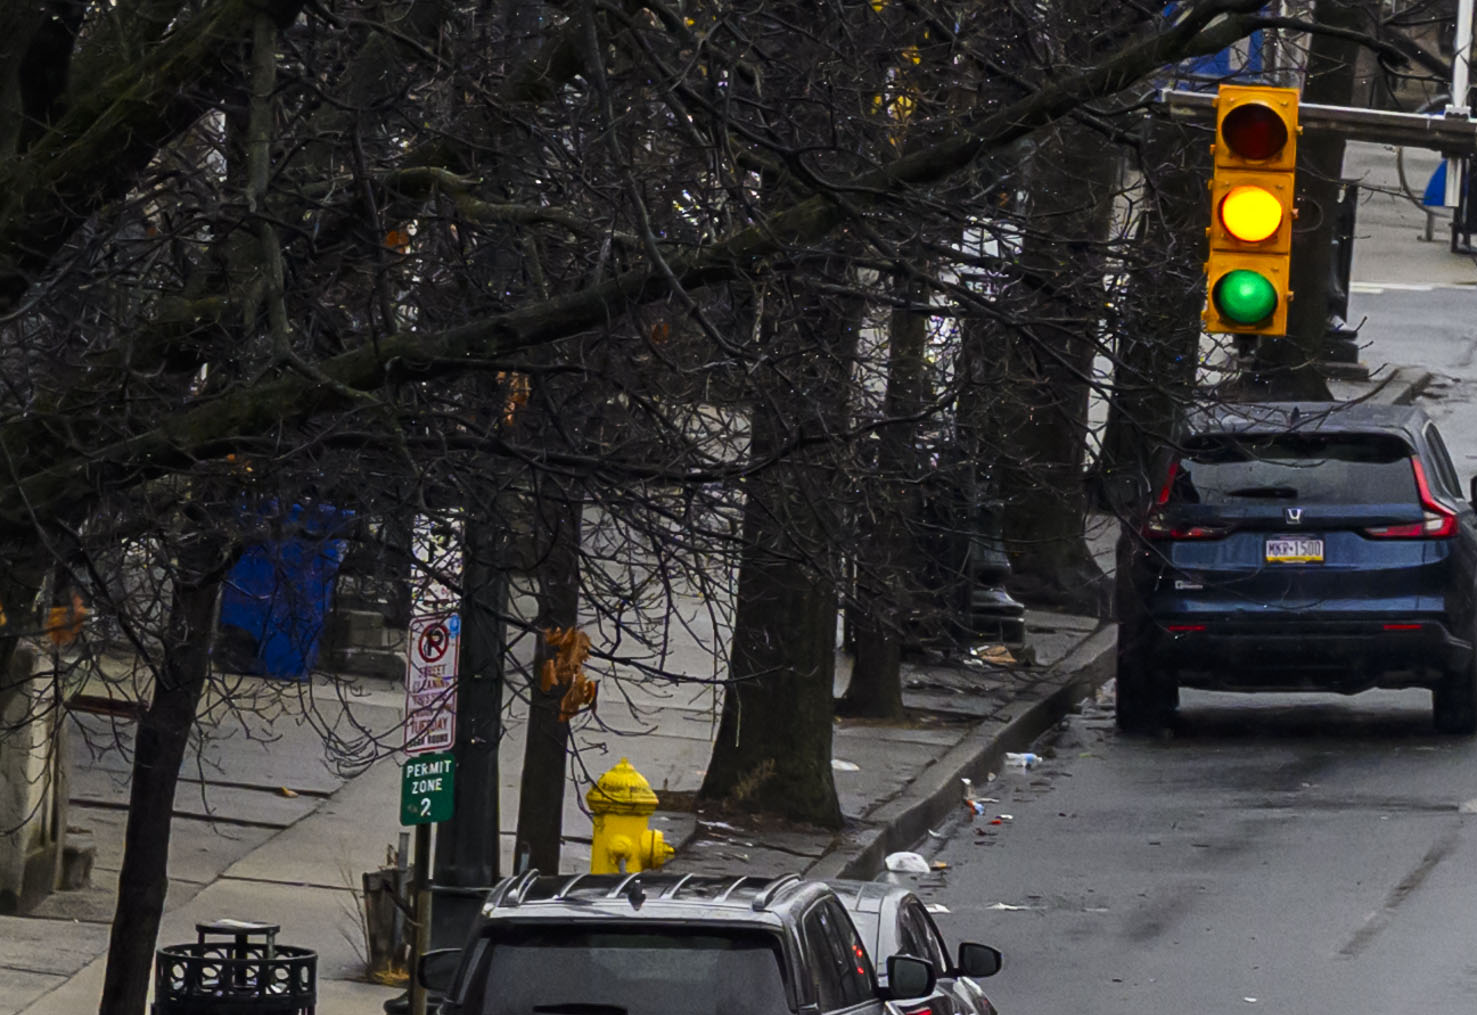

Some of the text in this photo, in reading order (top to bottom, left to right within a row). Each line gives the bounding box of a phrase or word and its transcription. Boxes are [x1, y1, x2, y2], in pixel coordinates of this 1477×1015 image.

[406, 760, 452, 778] PERMIT
[412, 778, 443, 794] ZONE
[420, 797, 432, 816] 2
